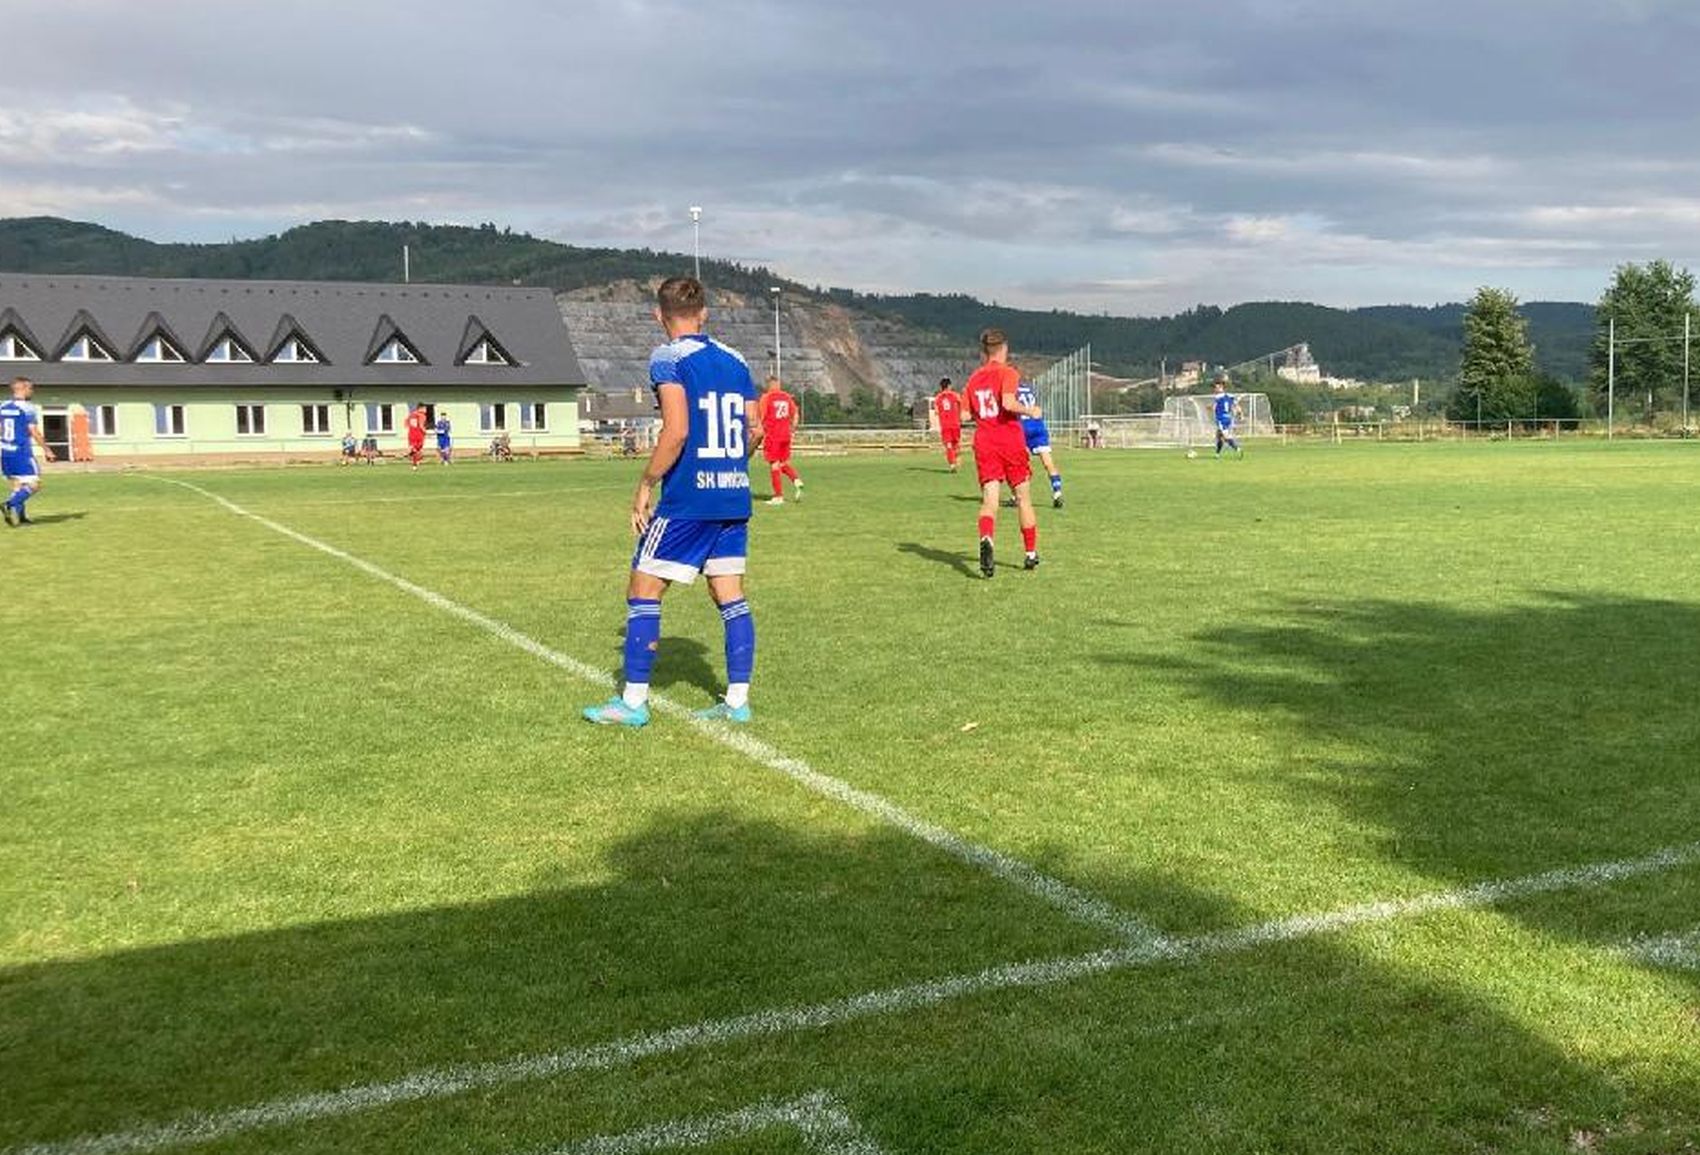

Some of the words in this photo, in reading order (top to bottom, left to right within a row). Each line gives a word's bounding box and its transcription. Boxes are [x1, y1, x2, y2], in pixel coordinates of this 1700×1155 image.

[773, 400, 789, 419] 23
[974, 389, 999, 419] 13
[697, 391, 744, 458] 16
[696, 470, 716, 489] SK
